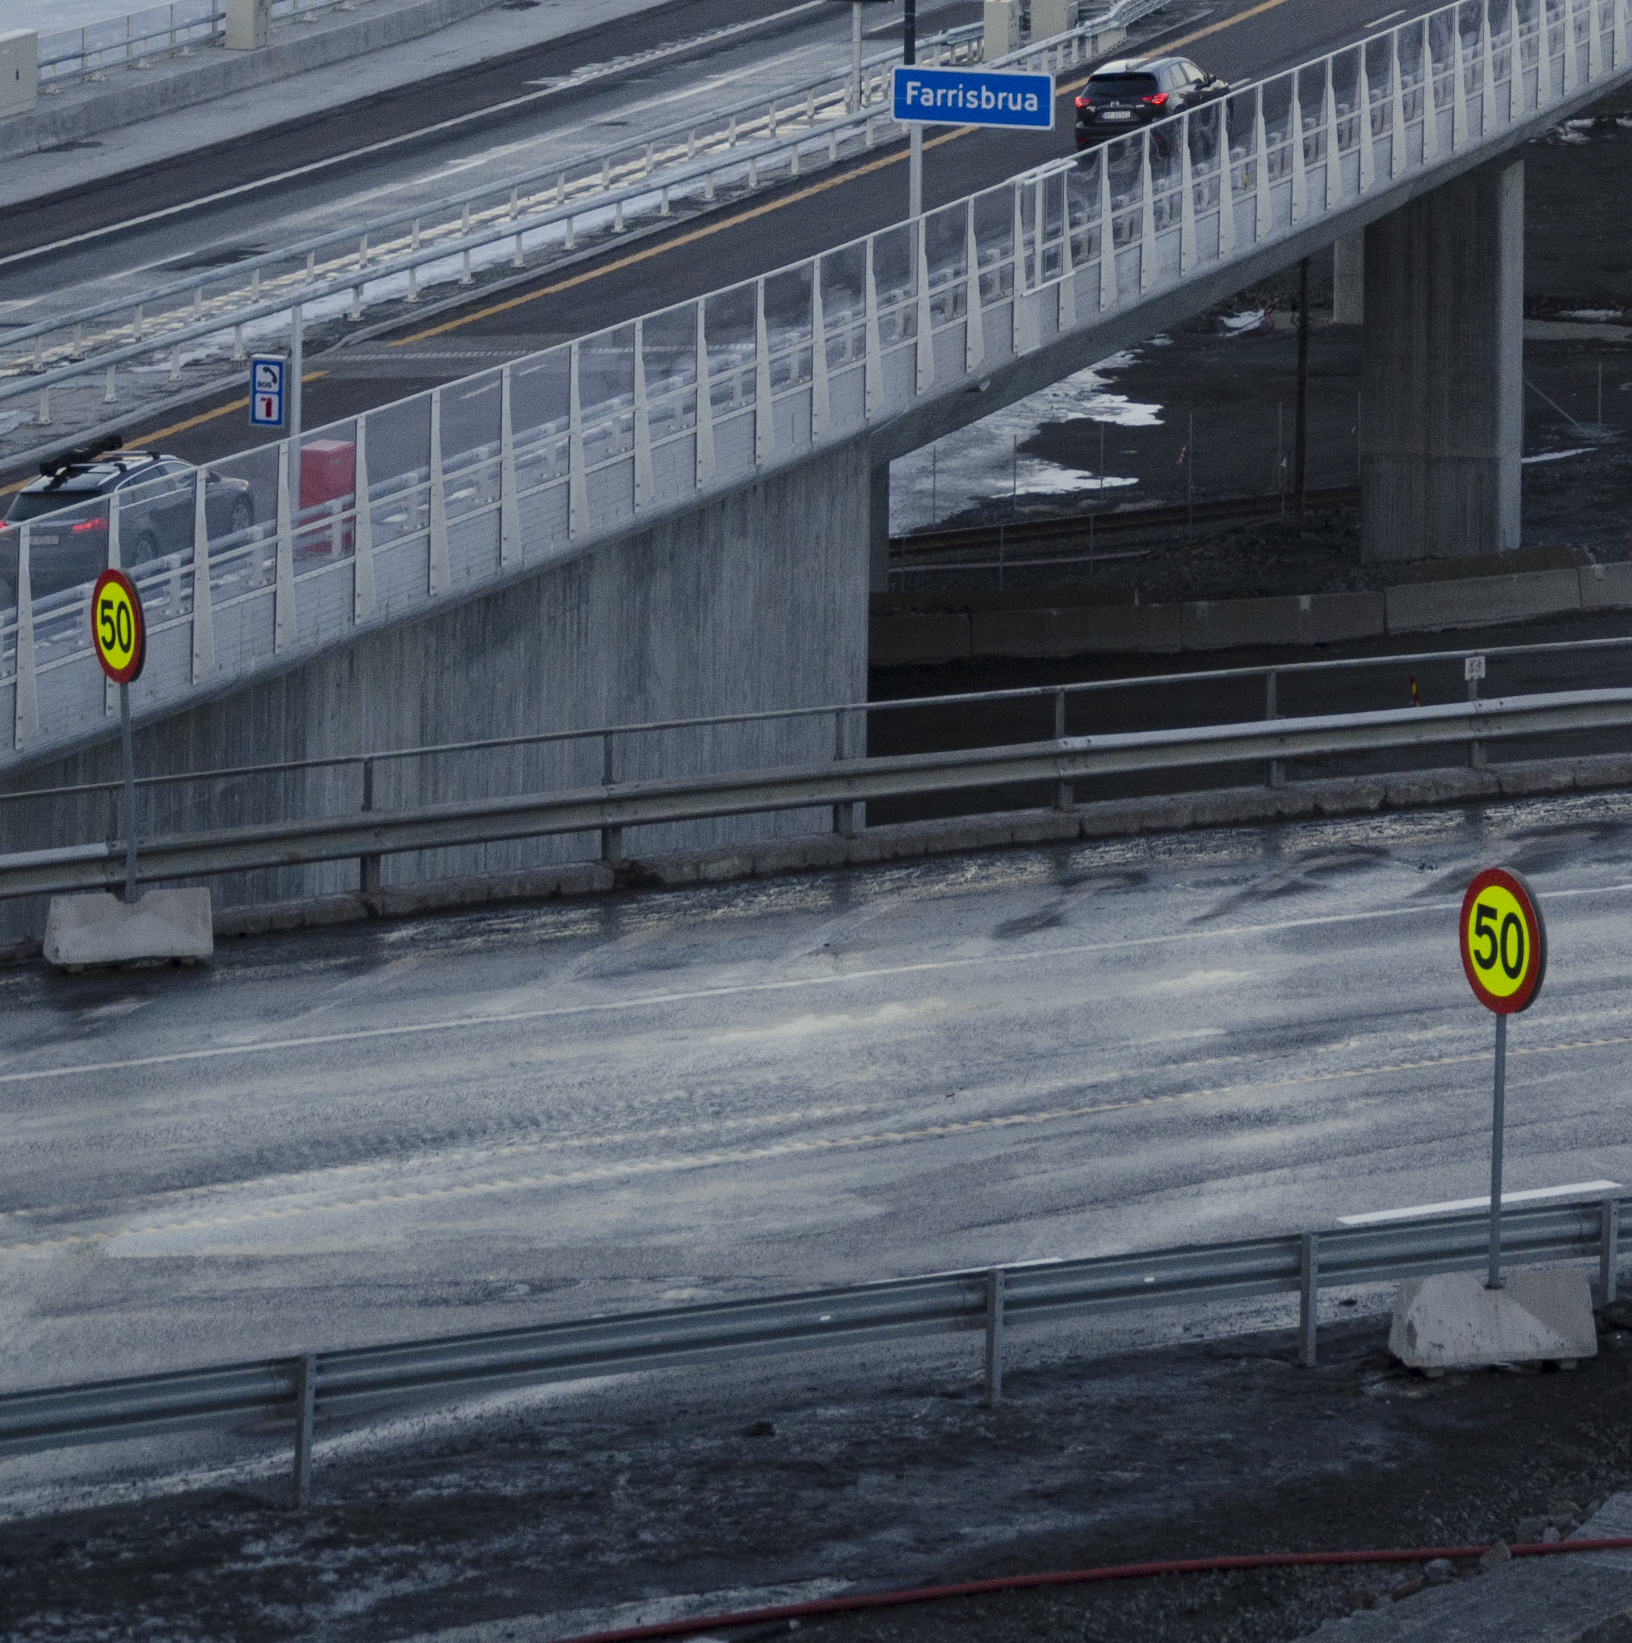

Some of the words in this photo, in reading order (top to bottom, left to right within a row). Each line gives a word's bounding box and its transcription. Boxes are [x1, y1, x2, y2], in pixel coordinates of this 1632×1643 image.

[906, 80, 1038, 112] Farrisbrua
[257, 380, 272, 388] SOS
[101, 599, 132, 654] 50
[1473, 902, 1525, 980] 50
